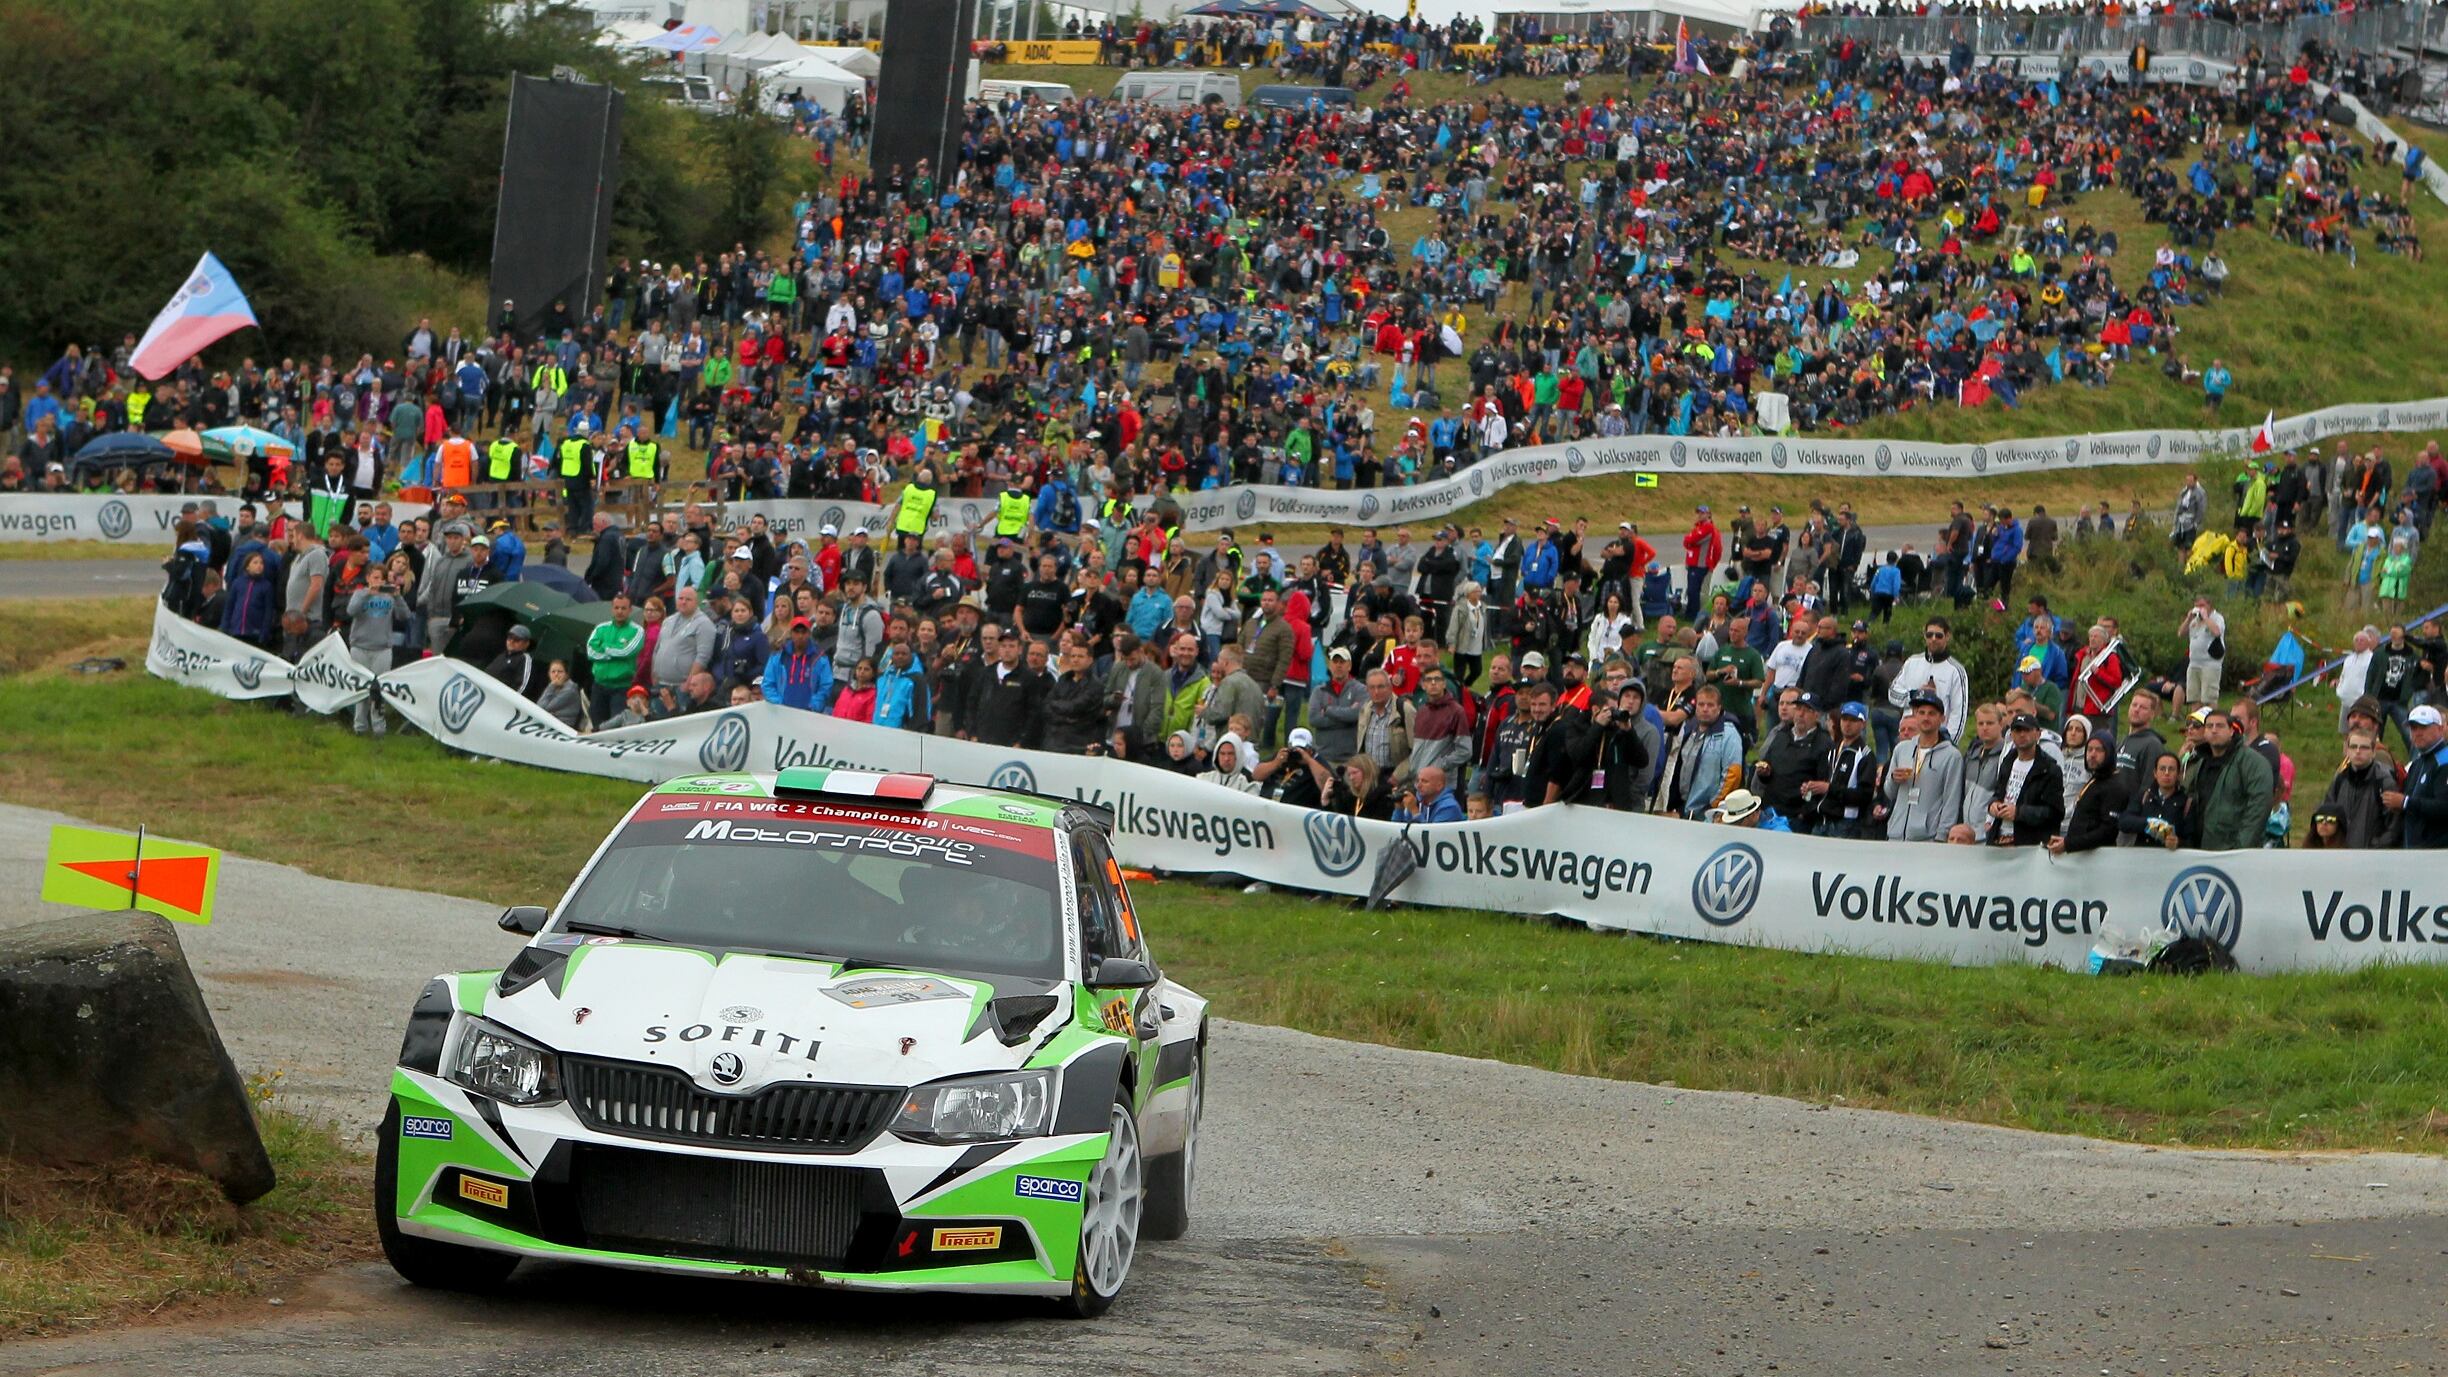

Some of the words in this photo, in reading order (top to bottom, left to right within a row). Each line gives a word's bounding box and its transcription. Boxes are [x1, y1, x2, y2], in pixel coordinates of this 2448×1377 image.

[1025, 45, 1053, 60] ADAC
[1269, 498, 1349, 518] Volkswagen
[1391, 484, 1464, 513] Volkswagen
[1490, 457, 1558, 482] Volkswagen
[1594, 448, 1661, 466] Volkswagen
[1697, 448, 1762, 466] Volkswagen
[1797, 449, 1865, 469] Volkswagen
[1901, 450, 1963, 469] Volkswagen
[1996, 449, 2059, 464] Volkswagen
[2090, 441, 2141, 456] Volkswagen
[1, 514, 77, 536] wagen
[714, 801, 744, 812] FIA
[750, 802, 790, 813] WRC
[795, 804, 807, 814] 2
[812, 806, 938, 829] Championship
[684, 819, 973, 866] Motorsport
[891, 829, 976, 852] Italia
[1401, 829, 1653, 900] Volkswagen
[1811, 871, 2109, 947] Volkswagen
[643, 1023, 822, 1062] SOFITI
[405, 1118, 451, 1136] sparco
[463, 1180, 503, 1203] PIRELLI
[1019, 1176, 1079, 1197] sparco
[939, 1231, 996, 1247] PIRELLI
